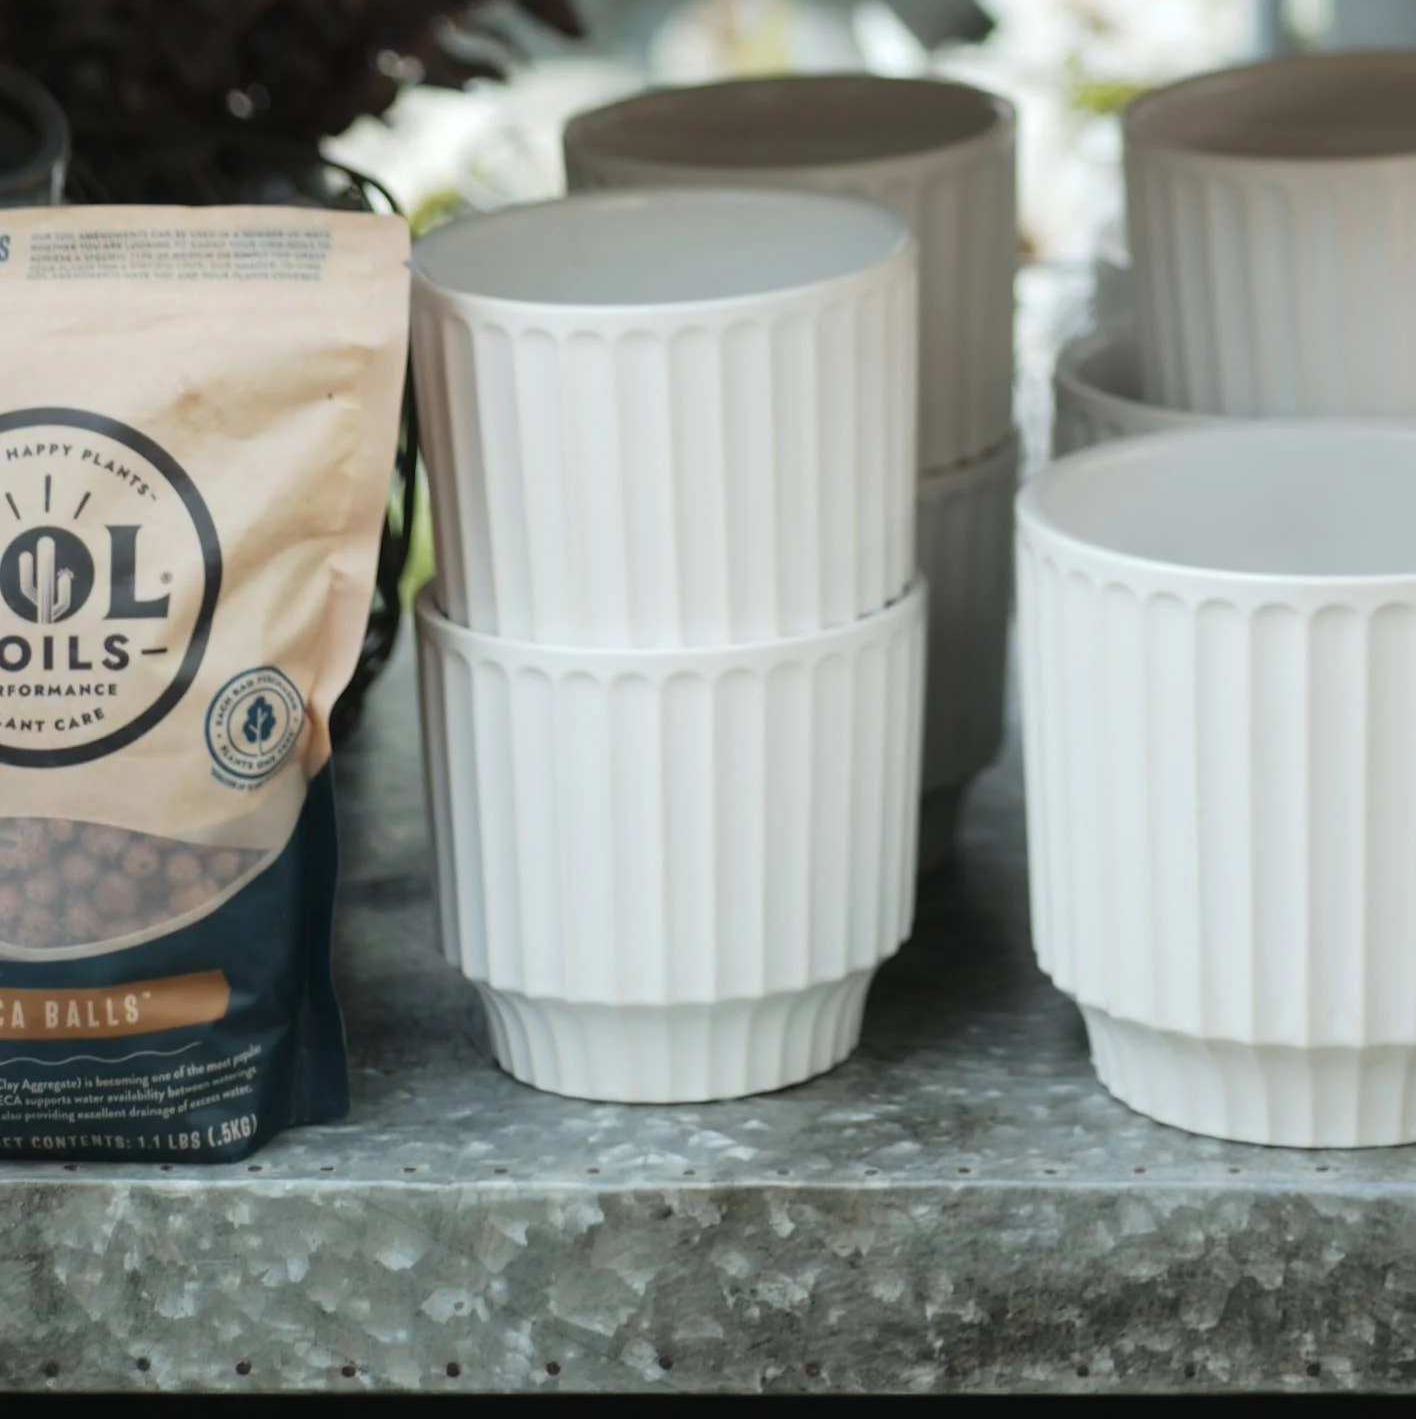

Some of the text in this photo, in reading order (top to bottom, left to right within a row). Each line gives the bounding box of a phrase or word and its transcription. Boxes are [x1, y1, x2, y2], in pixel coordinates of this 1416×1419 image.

[6, 443, 74, 461] HAPPY
[0, 634, 130, 671] OILS
[0, 708, 105, 734] ANT CARE
[22, 1062, 205, 1094] Aggregate) becoming one of the
[108, 1086, 165, 1103] availability
[25, 1104, 175, 1123] providing excellent drainage
[32, 1114, 257, 1149] CONTENTS: 1.1 LBS (.5KG)
